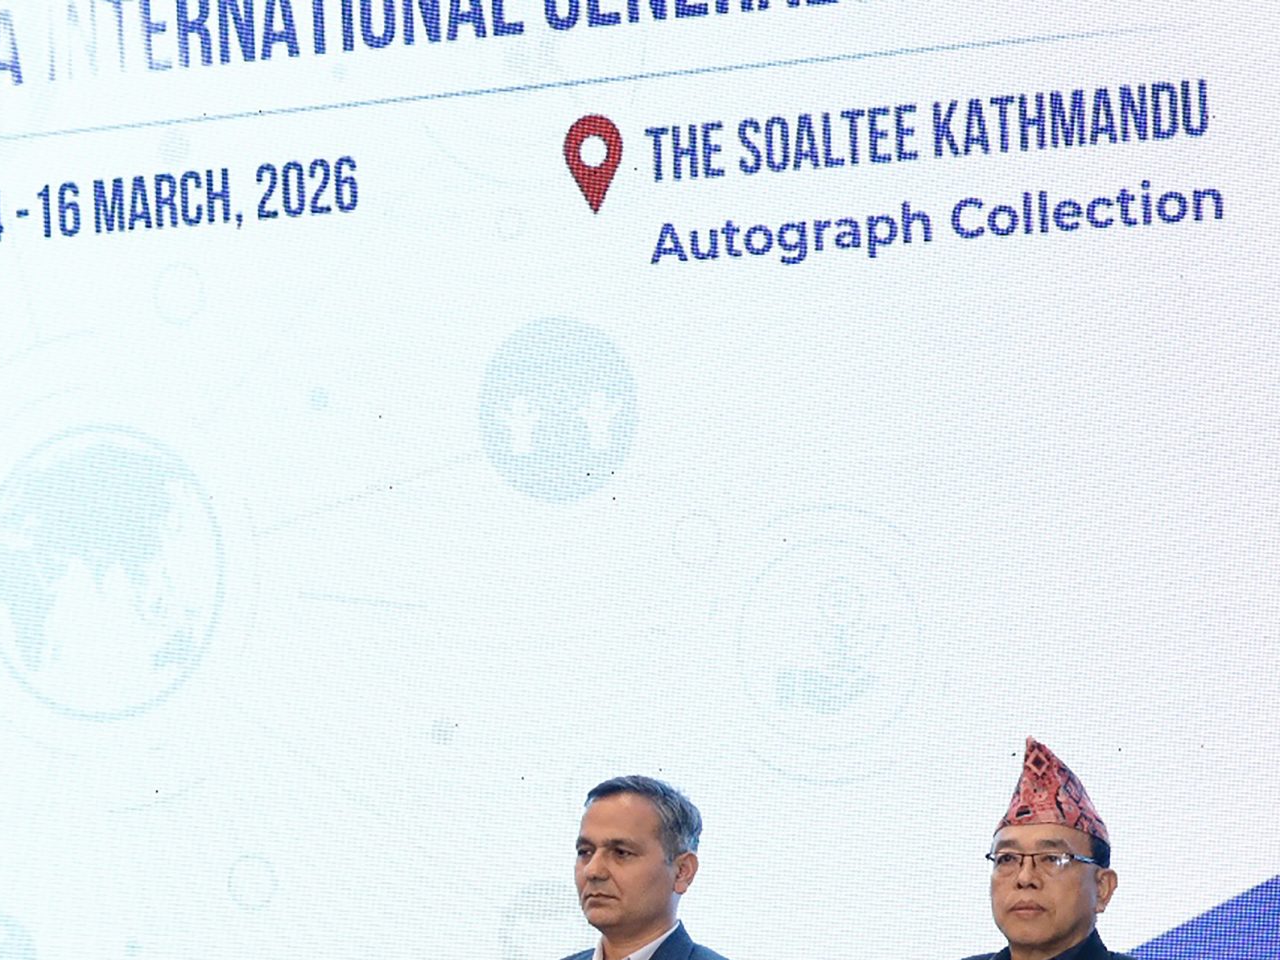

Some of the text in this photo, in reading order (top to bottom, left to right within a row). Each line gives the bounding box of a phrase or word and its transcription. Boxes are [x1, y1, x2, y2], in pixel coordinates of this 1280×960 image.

[643, 79, 1209, 183] THE SOALTEE KATHMANDU
[92, 167, 244, 234] MARCH,
[255, 155, 359, 221] 2026
[650, 179, 1224, 265] Autograph Collection
